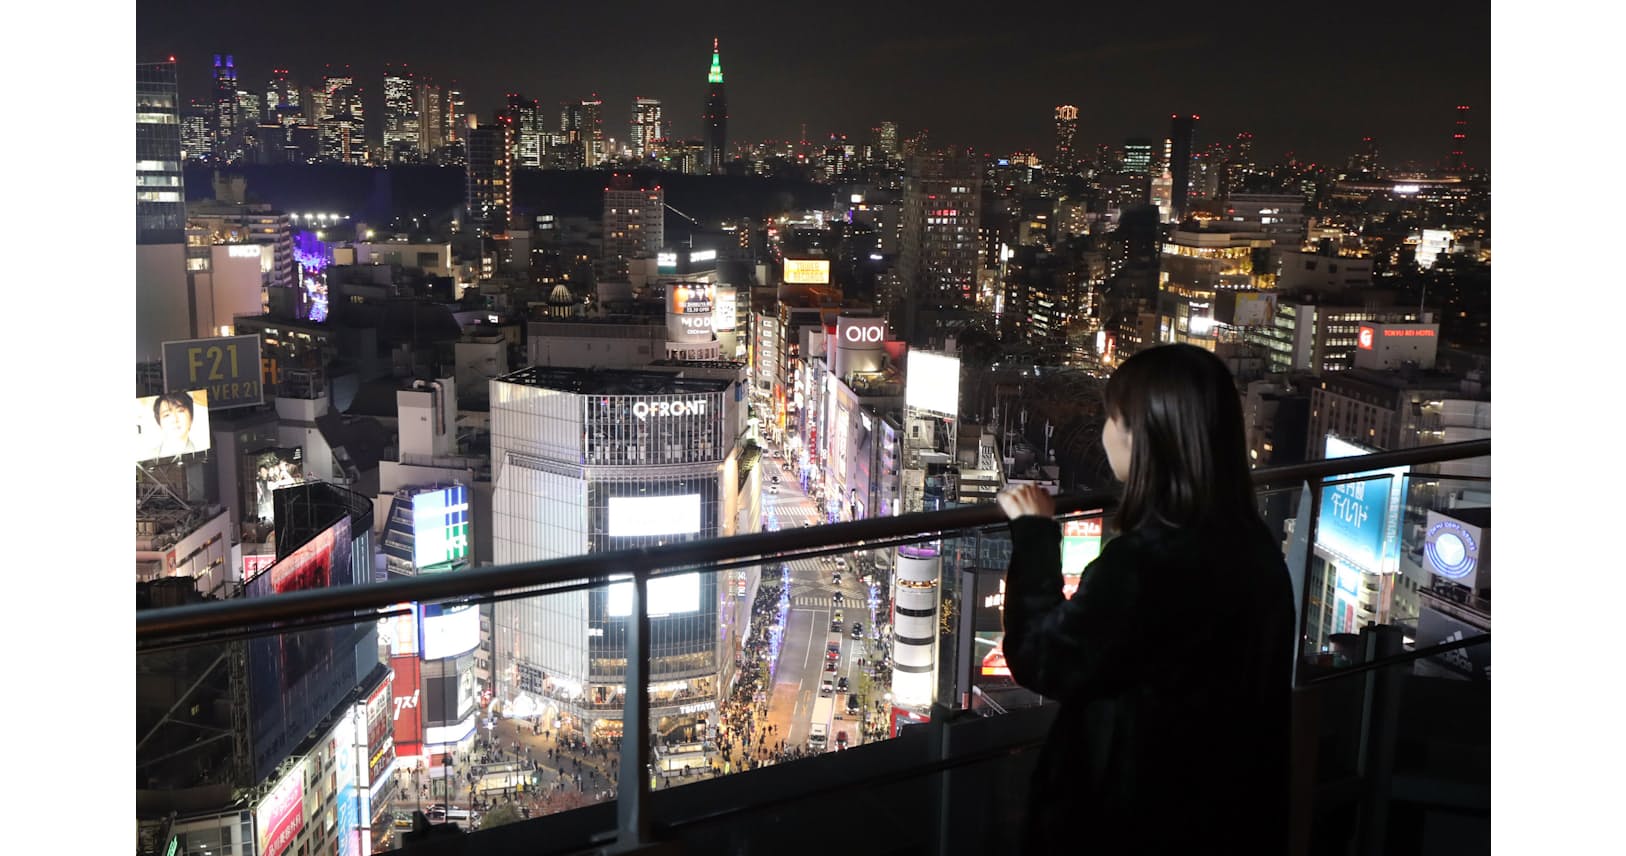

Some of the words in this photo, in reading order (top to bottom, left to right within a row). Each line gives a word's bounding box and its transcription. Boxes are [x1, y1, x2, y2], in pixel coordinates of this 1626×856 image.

[1384, 329, 1404, 337] TOKYU
[1416, 329, 1434, 337] HOTEL
[187, 344, 238, 383] F21
[633, 400, 707, 421] QFRONT
[1462, 530, 1477, 551] STORE
[680, 701, 716, 714] TSUTAYA
